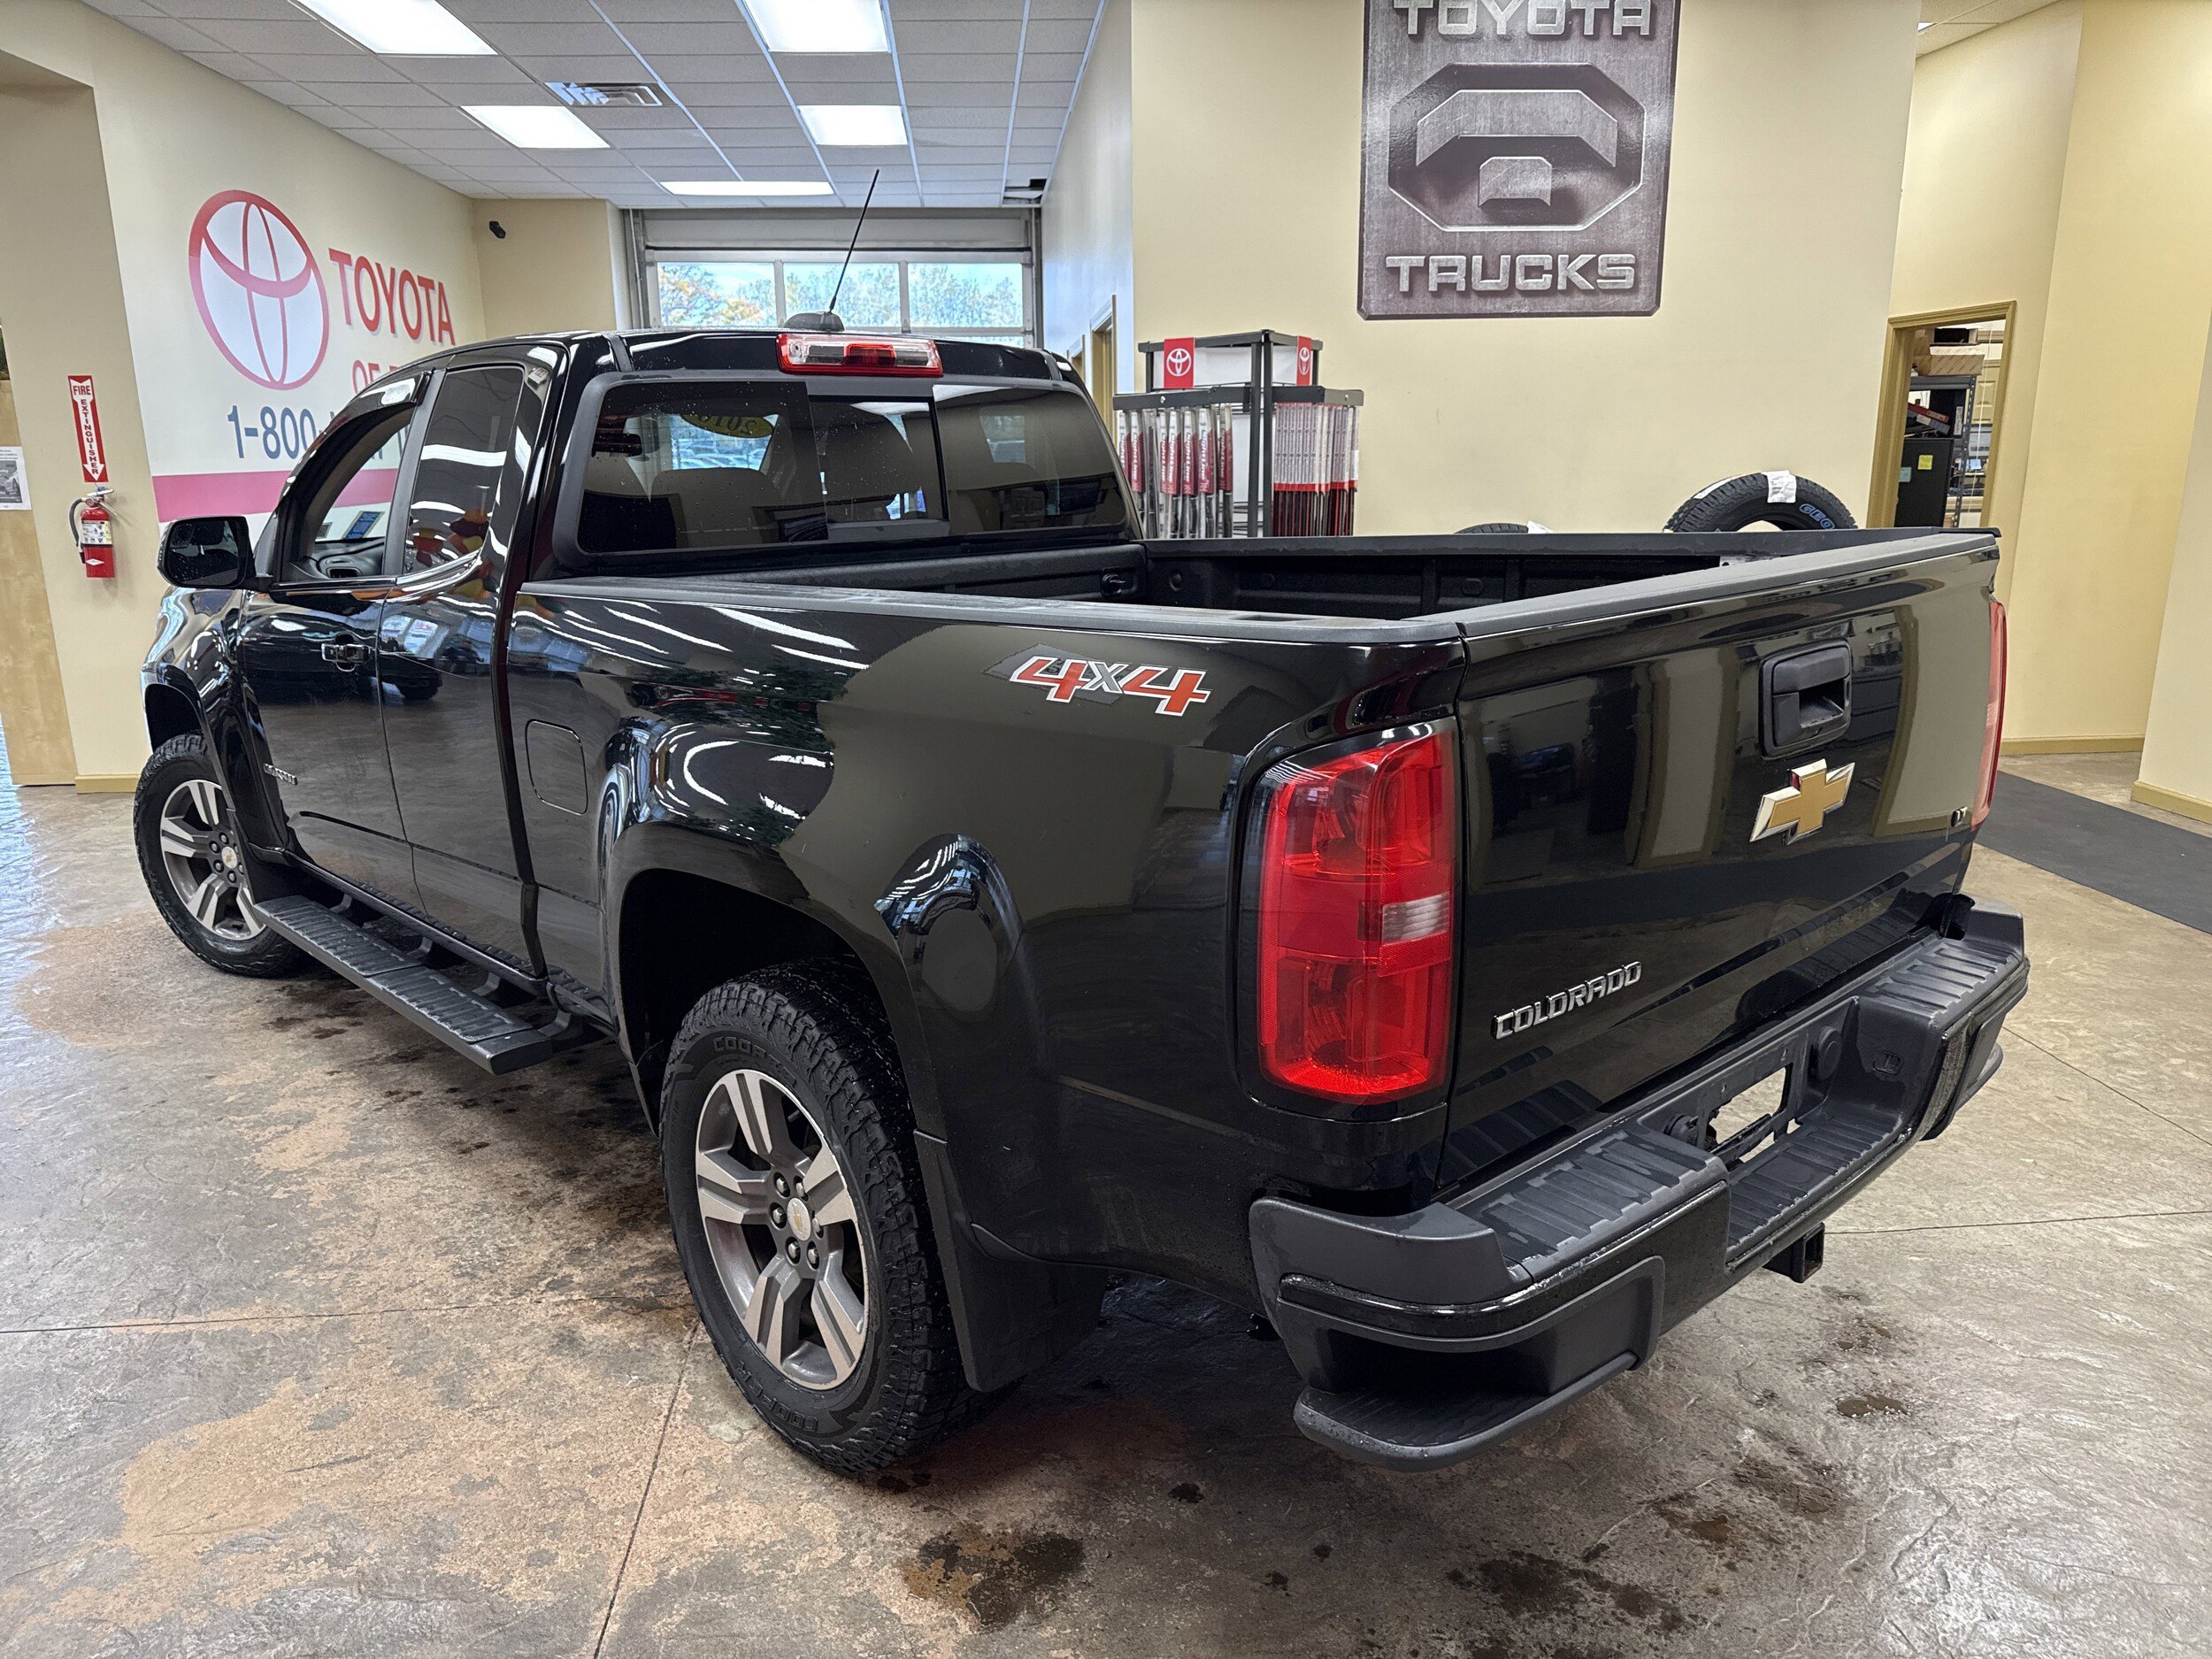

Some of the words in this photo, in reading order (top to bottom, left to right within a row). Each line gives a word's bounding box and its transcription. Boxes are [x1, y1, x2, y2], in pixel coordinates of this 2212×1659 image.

[1394, 0, 1649, 35] TOYOTA
[328, 248, 455, 345] TOYOTA
[1386, 254, 1635, 291] TRUCKS
[73, 385, 91, 396] FIRE
[81, 398, 99, 474] EXTINGUISHER
[1491, 961, 1642, 1040] COLORADO
